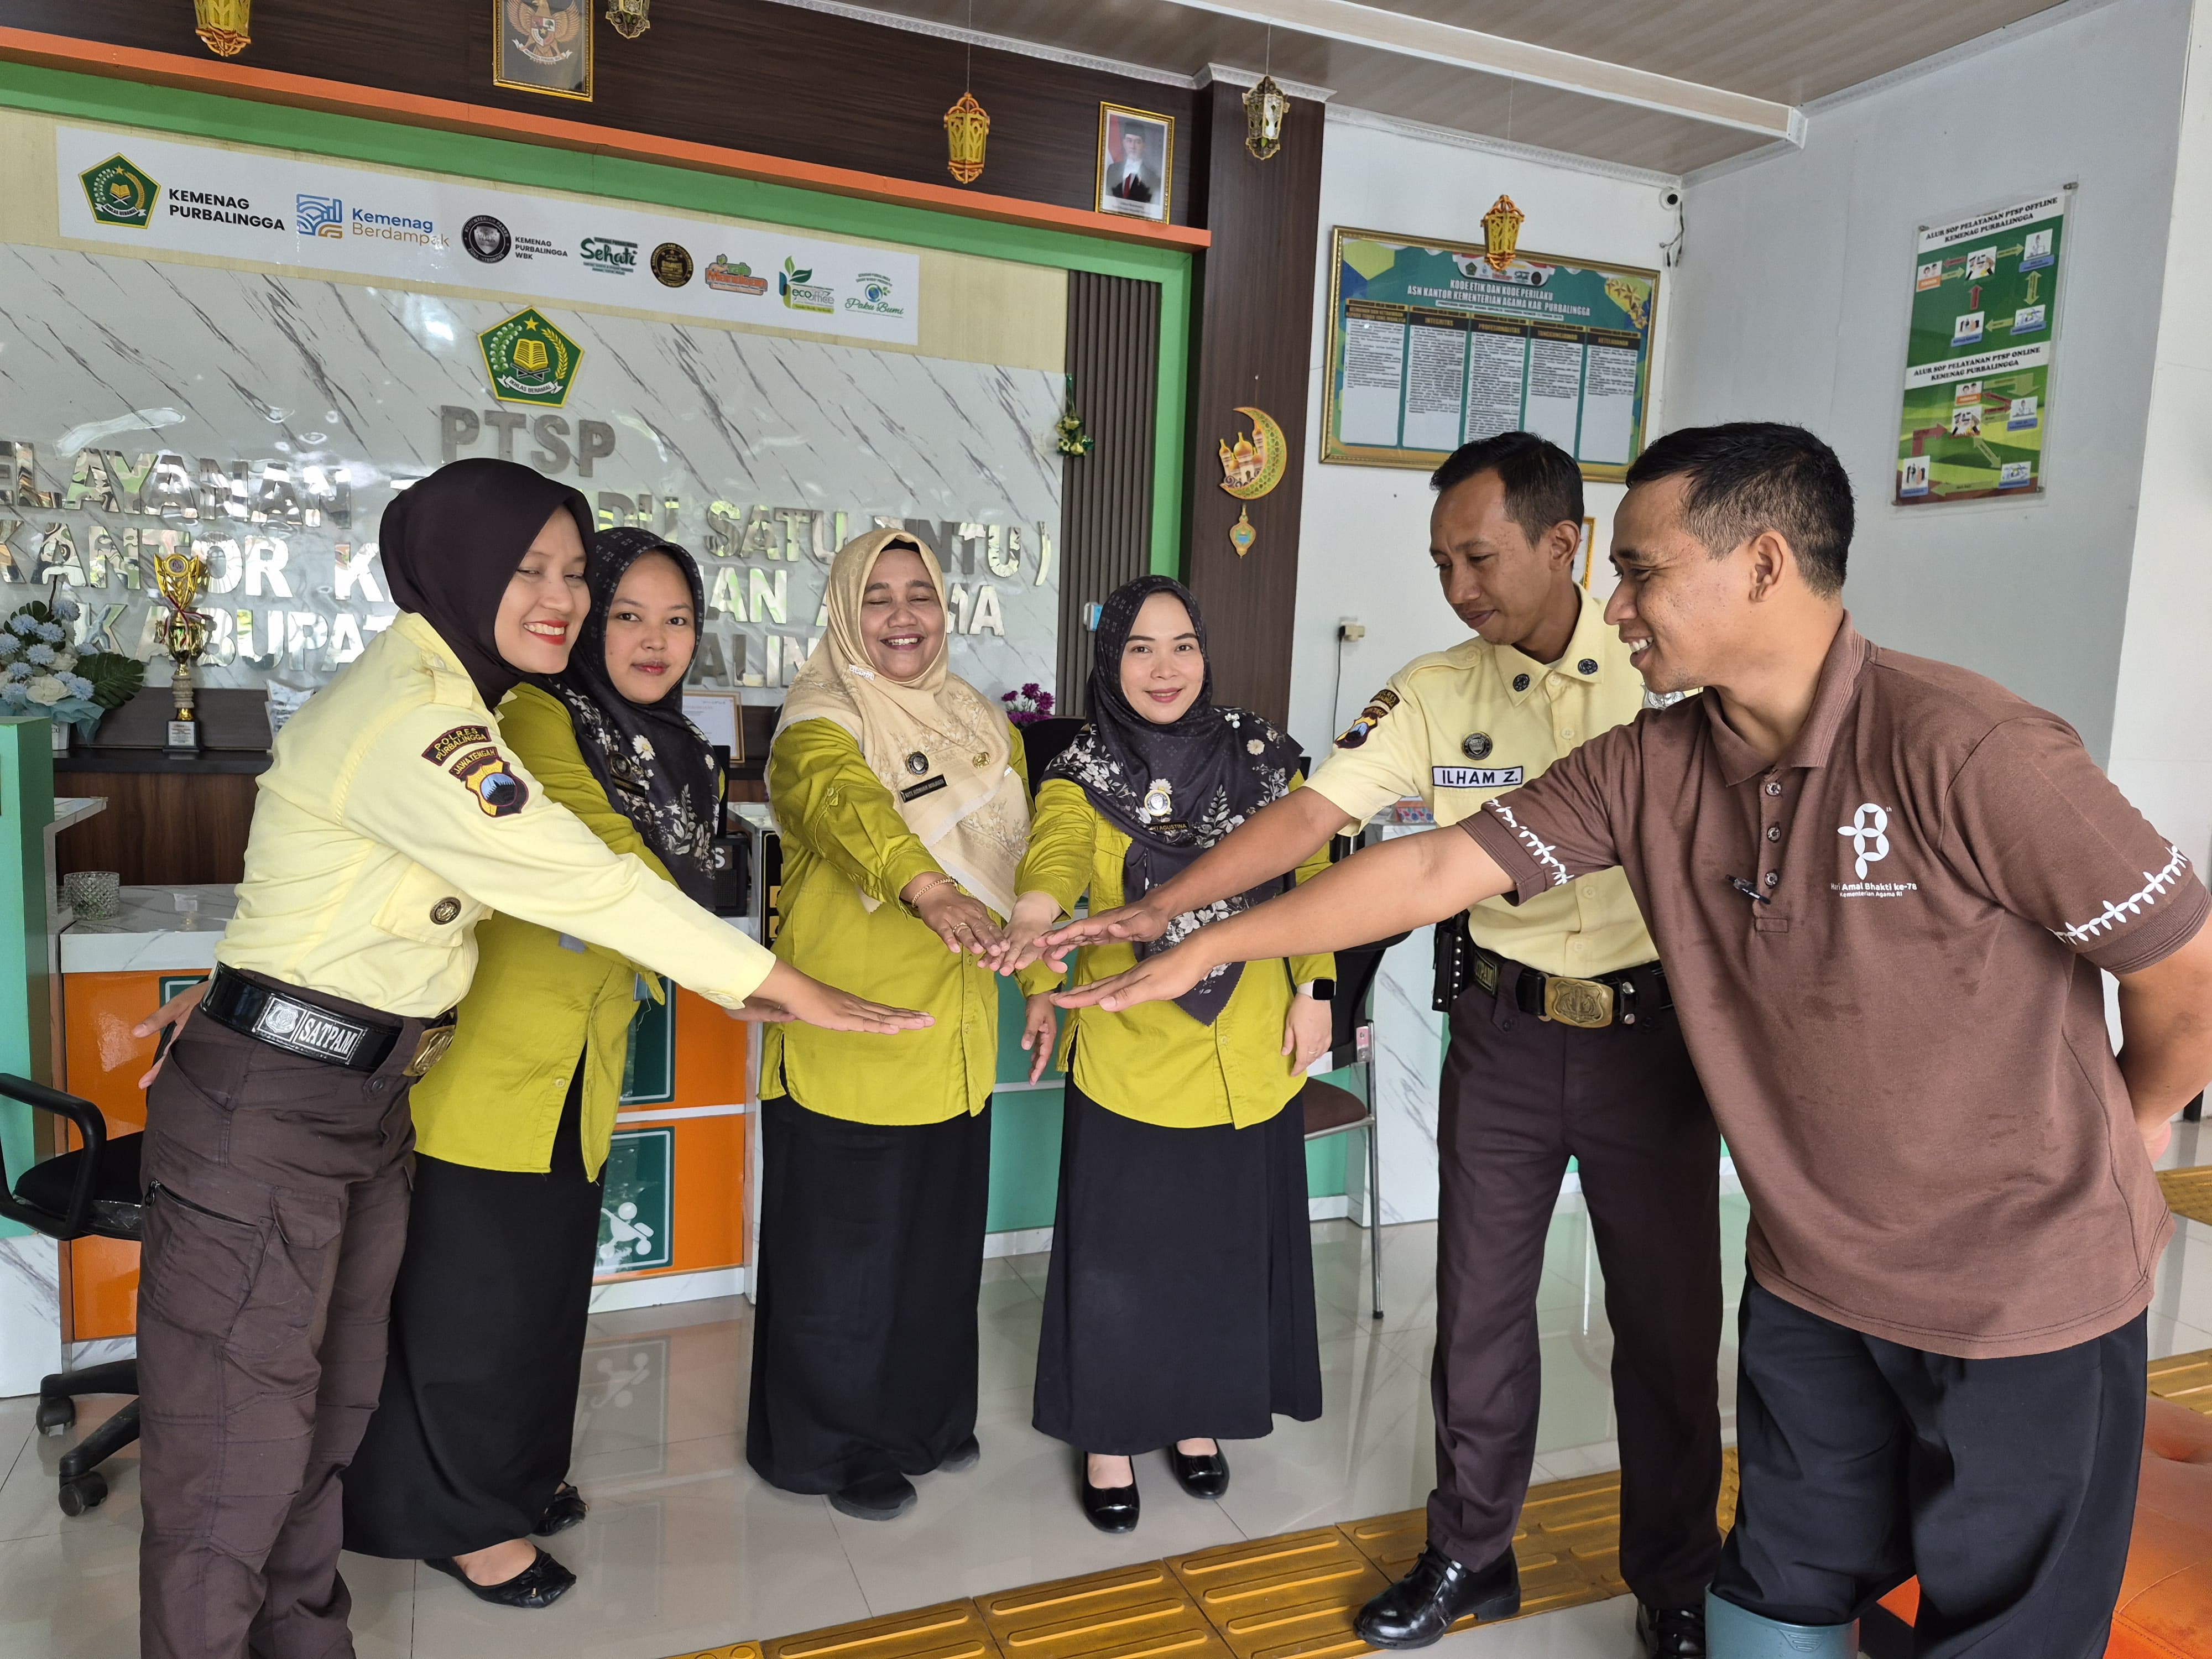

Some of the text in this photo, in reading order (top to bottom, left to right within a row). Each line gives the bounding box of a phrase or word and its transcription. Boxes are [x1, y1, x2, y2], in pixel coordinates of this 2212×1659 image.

[168, 188, 250, 210] KEMENAG
[169, 205, 285, 231] PURBALINGGA
[351, 207, 434, 233] Kemenag
[1926, 197, 2058, 239] ALUR SOP PELAYANAN PTSP OFFLINE
[1944, 213, 2033, 243] KEMENAG PURBALINGGA
[352, 222, 450, 247] Berdampak
[515, 236, 552, 247] KEMENAG
[515, 244, 568, 257] PURBALINGGA
[580, 237, 638, 265] Sehati
[1407, 285, 1423, 296] ASN
[1423, 287, 1452, 300] KANTOR
[1453, 290, 1501, 306] KEMENTERIAN
[1502, 295, 1527, 309] AGAMA
[1545, 299, 1591, 317] PURBALINGGA
[1450, 279, 1554, 301] KODE ETIK DAN KODE PERILAKU
[844, 298, 875, 310] Paku
[877, 301, 904, 315] Bumi
[1914, 347, 2041, 376] ALUR SOP PELAYANAN PTSP ONLINE
[1931, 359, 2018, 381] KEMENAG PURBALINGGA
[509, 379, 527, 392] IKHLAS
[441, 404, 617, 479] PTSP
[703, 500, 849, 565] SATU
[434, 727, 478, 752] POLRES
[435, 734, 487, 761] PURBALINGGA
[1442, 769, 1519, 785] ILHAM Z.
[1841, 882, 1863, 890] Amal
[298, 1018, 357, 1055] SATPAM
